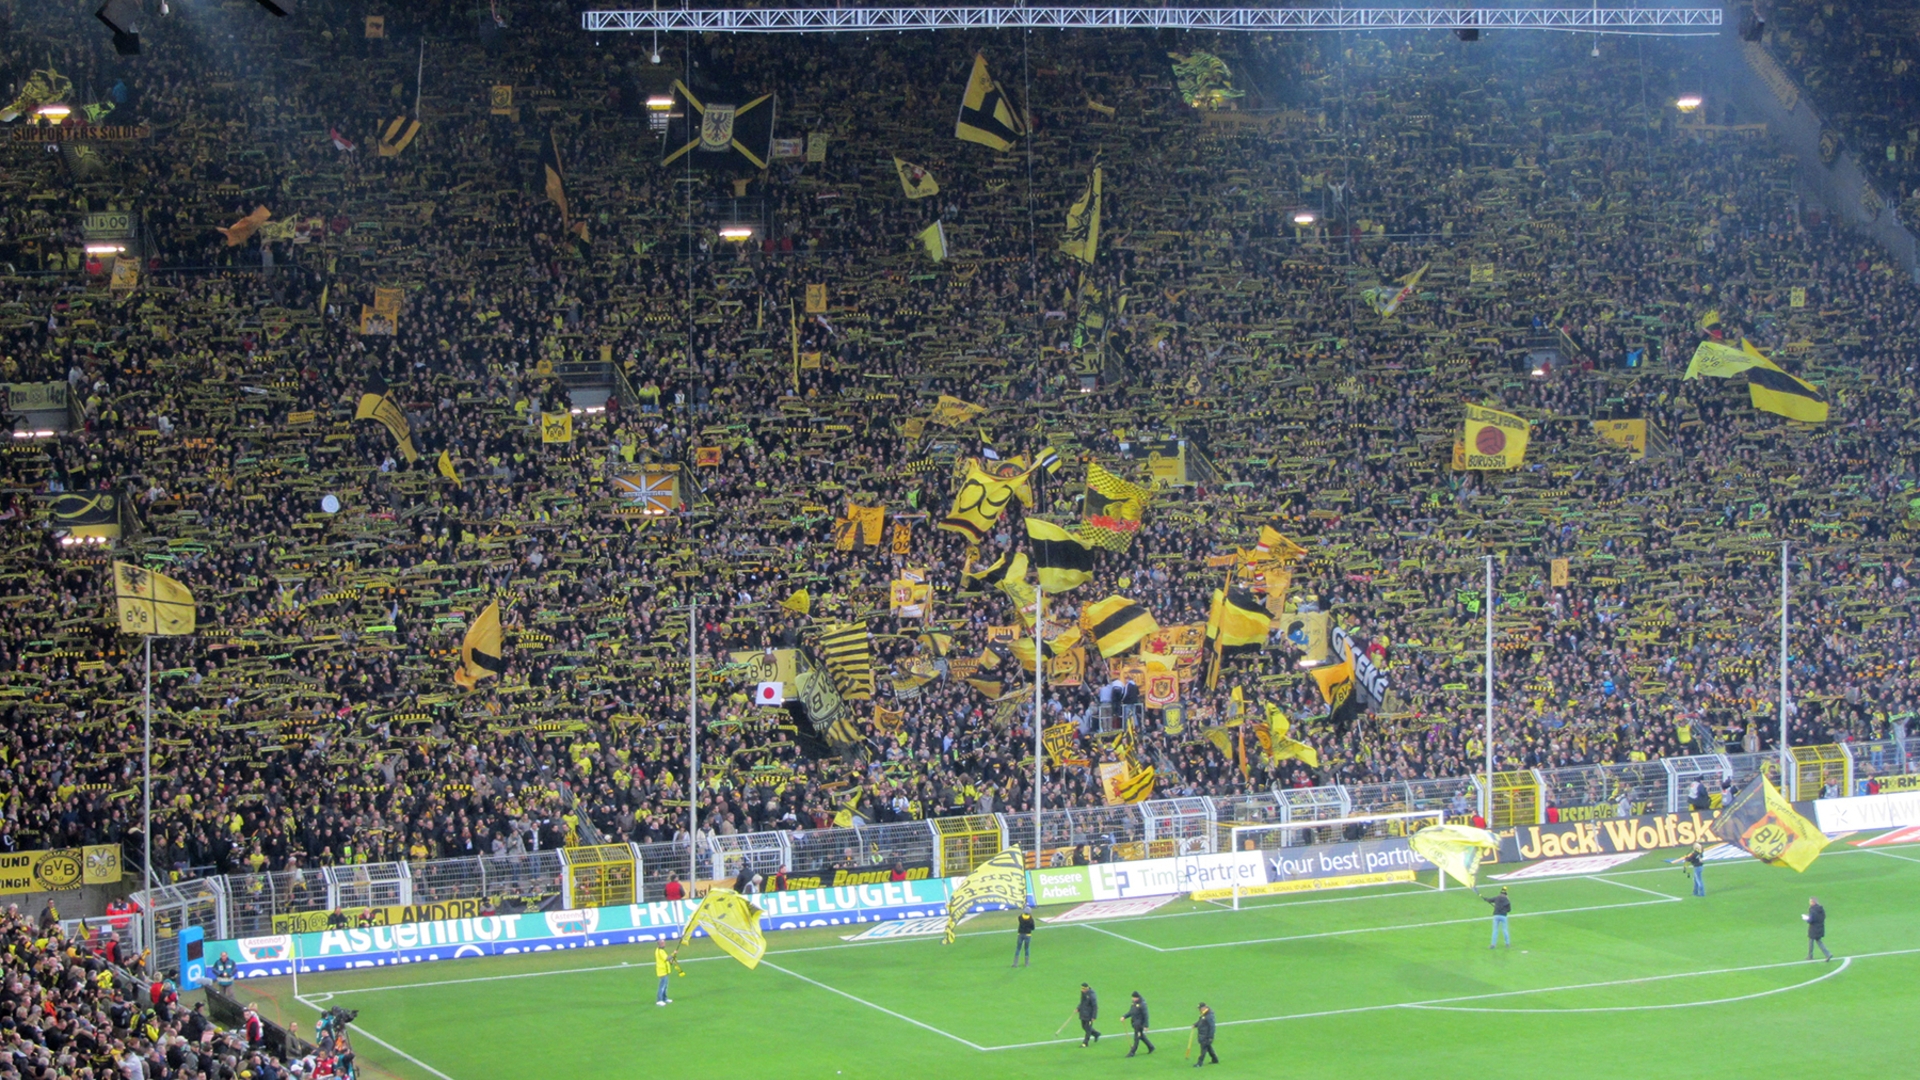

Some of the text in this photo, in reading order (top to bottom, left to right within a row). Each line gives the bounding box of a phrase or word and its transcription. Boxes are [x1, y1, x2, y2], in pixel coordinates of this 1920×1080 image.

[12, 127, 97, 140] SUPPORTERS
[1467, 455, 1507, 468] BORUSSIA
[1521, 822, 1604, 860] Jack
[1269, 857, 1314, 876] Your
[1320, 850, 1360, 872] best
[1039, 873, 1083, 886] Bessere
[1042, 886, 1080, 899] Arbeit.
[247, 936, 283, 946] Astenhof
